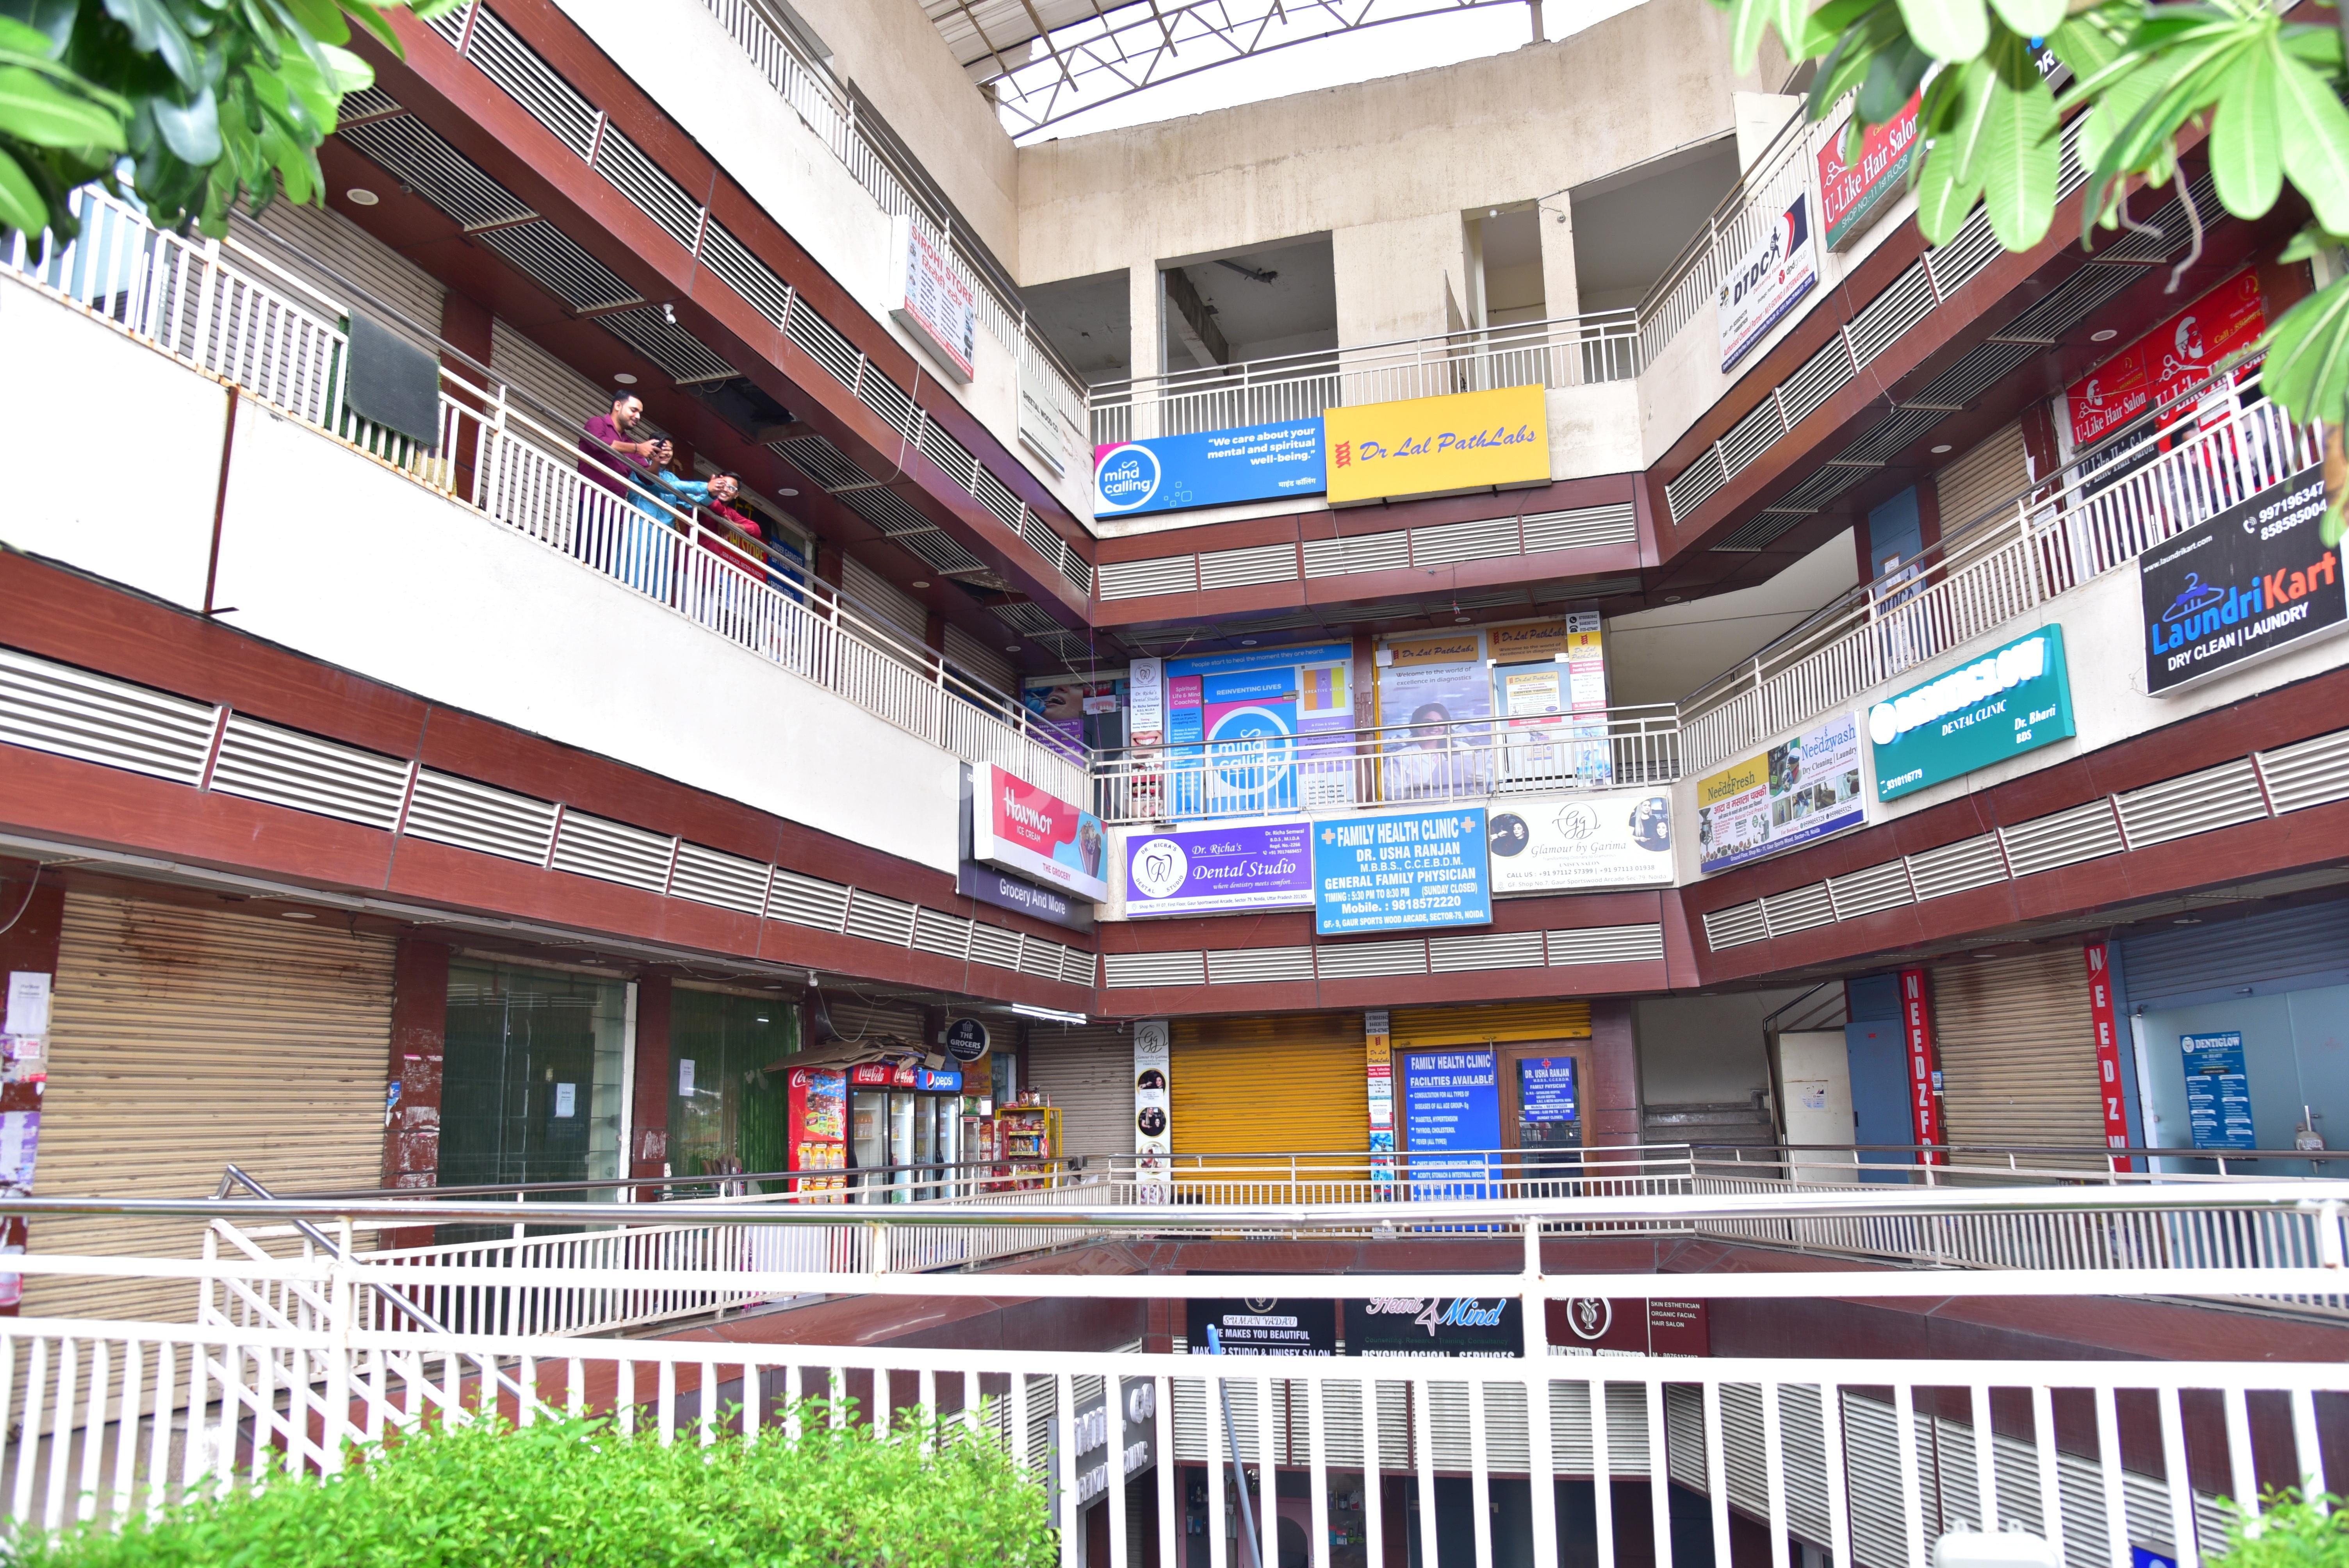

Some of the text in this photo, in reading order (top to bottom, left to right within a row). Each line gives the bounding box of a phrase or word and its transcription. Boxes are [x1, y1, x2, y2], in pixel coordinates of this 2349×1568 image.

[1825, 172, 1862, 223] U-Like
[1863, 143, 1887, 185] Hair
[1842, 207, 1857, 228] SHOP
[1887, 154, 1907, 181] FLOOR
[912, 226, 943, 271] SIROHI
[946, 267, 973, 307] STORE
[1734, 251, 1769, 307] DTDC
[1023, 390, 1058, 433] SHEETAL WOOD CO
[2076, 392, 2146, 443] U-Like Hair Salon
[1232, 435, 1255, 444] care
[1257, 430, 1289, 441] about
[1291, 428, 1315, 438] your
[1360, 424, 1537, 461] Dr Lal PathLabs
[1208, 438, 1315, 459] mental and spiritual
[1105, 467, 1139, 482] mind
[1105, 479, 1150, 494] calling
[2259, 481, 2324, 523] 997196347
[2261, 499, 2328, 540] 858585004
[2144, 535, 2212, 573] www.laundrikart.com
[2152, 551, 2336, 655] LaundriKart
[2168, 602, 2309, 671] DRY CLEAN LAUNDRY
[1217, 685, 1262, 696] REINVENTING
[1942, 700, 2007, 736] DENTAL CLINIC
[2015, 704, 2056, 731] Dr. Bharti
[1802, 723, 1855, 761] Needzwash
[2016, 729, 2032, 743] BDS
[1802, 766, 1811, 775] Dry
[1812, 757, 1832, 770] Cleaning
[1836, 747, 1857, 760] Laundry
[1708, 771, 1755, 800] NeedzFresh
[1003, 787, 1052, 835] Havmor
[1714, 804, 1725, 814] आटा
[1731, 794, 1749, 807] मसाला
[1026, 829, 1041, 843] CREAM
[1337, 817, 1459, 847] FAMILY HEALTH CLINIC
[1192, 842, 1242, 855] Dr. Richa's
[1356, 842, 1460, 862] DR. USHA RANJAN
[1531, 841, 1626, 858] Glamour by Garima
[1043, 862, 1071, 881] THE GROCERY
[1193, 858, 1296, 880] Dental Studio
[1404, 856, 1463, 869] C.C.E.B.D.M.
[1230, 880, 1253, 889] dentistry
[1325, 867, 1476, 889] GENERAL FAMILY PHYSICIAN
[1000, 878, 1066, 915] Grocery And More
[1342, 896, 1461, 914] Mobile. 9818572220
[950, 1039, 980, 1048] GROCERS
[2194, 1037, 2240, 1048] DENTIGLOW
[1411, 1055, 1491, 1070] FAMILY HEALTH CLINIC
[1525, 1068, 1569, 1078] DR. USHA RANJAN
[936, 1075, 954, 1088] pepsi
[1410, 1076, 1450, 1086] FACILITIES
[1224, 1316, 1260, 1325] SUMAN
[1439, 1297, 1506, 1326] Mind
[1226, 1329, 1310, 1340] MAKES YOU BEAUTIFUL
